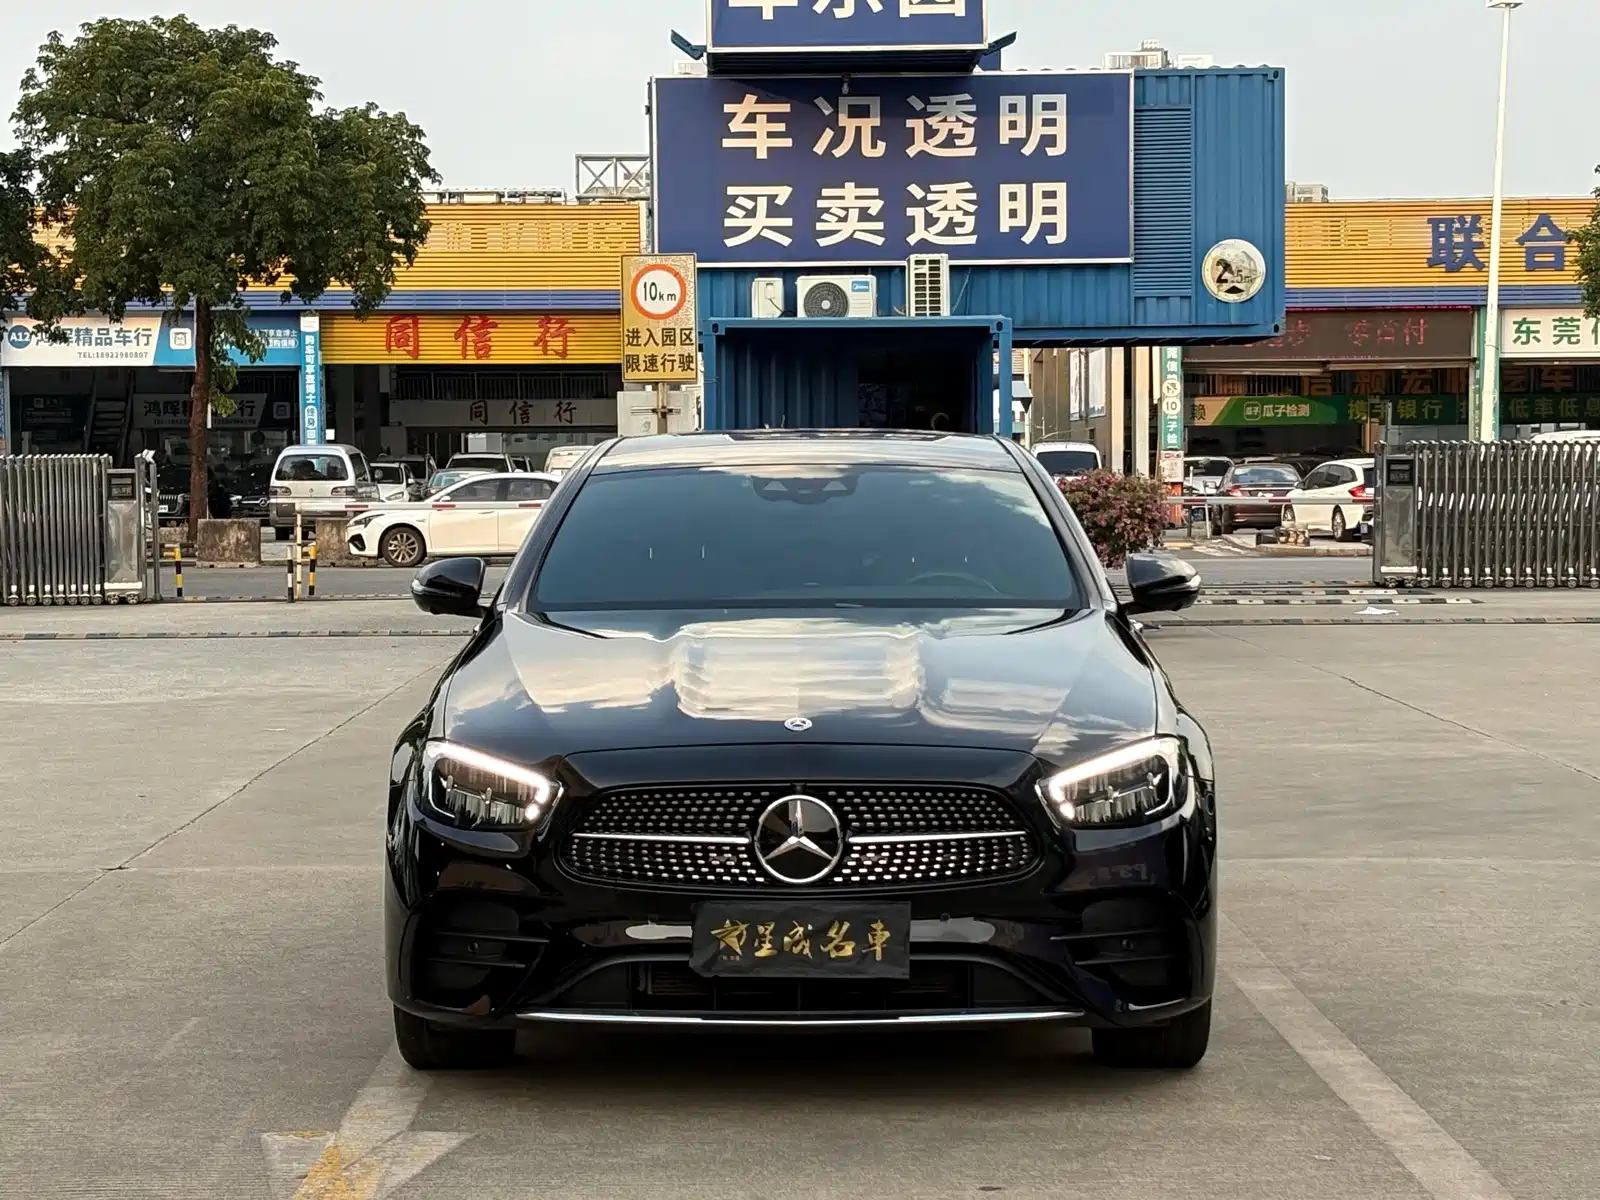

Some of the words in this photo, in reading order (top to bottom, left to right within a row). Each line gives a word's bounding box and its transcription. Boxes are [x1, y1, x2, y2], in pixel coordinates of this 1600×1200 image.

[722, 93, 1068, 159] 车况透明
[723, 181, 1068, 248] 买卖透明
[1426, 213, 1569, 273] 联合
[10, 332, 30, 342] A12
[385, 315, 577, 360] 同信行
[625, 327, 695, 347] 进入园区
[625, 354, 695, 373] 限速行驶
[469, 401, 578, 425] 同信行
[1166, 401, 1177, 411] 10
